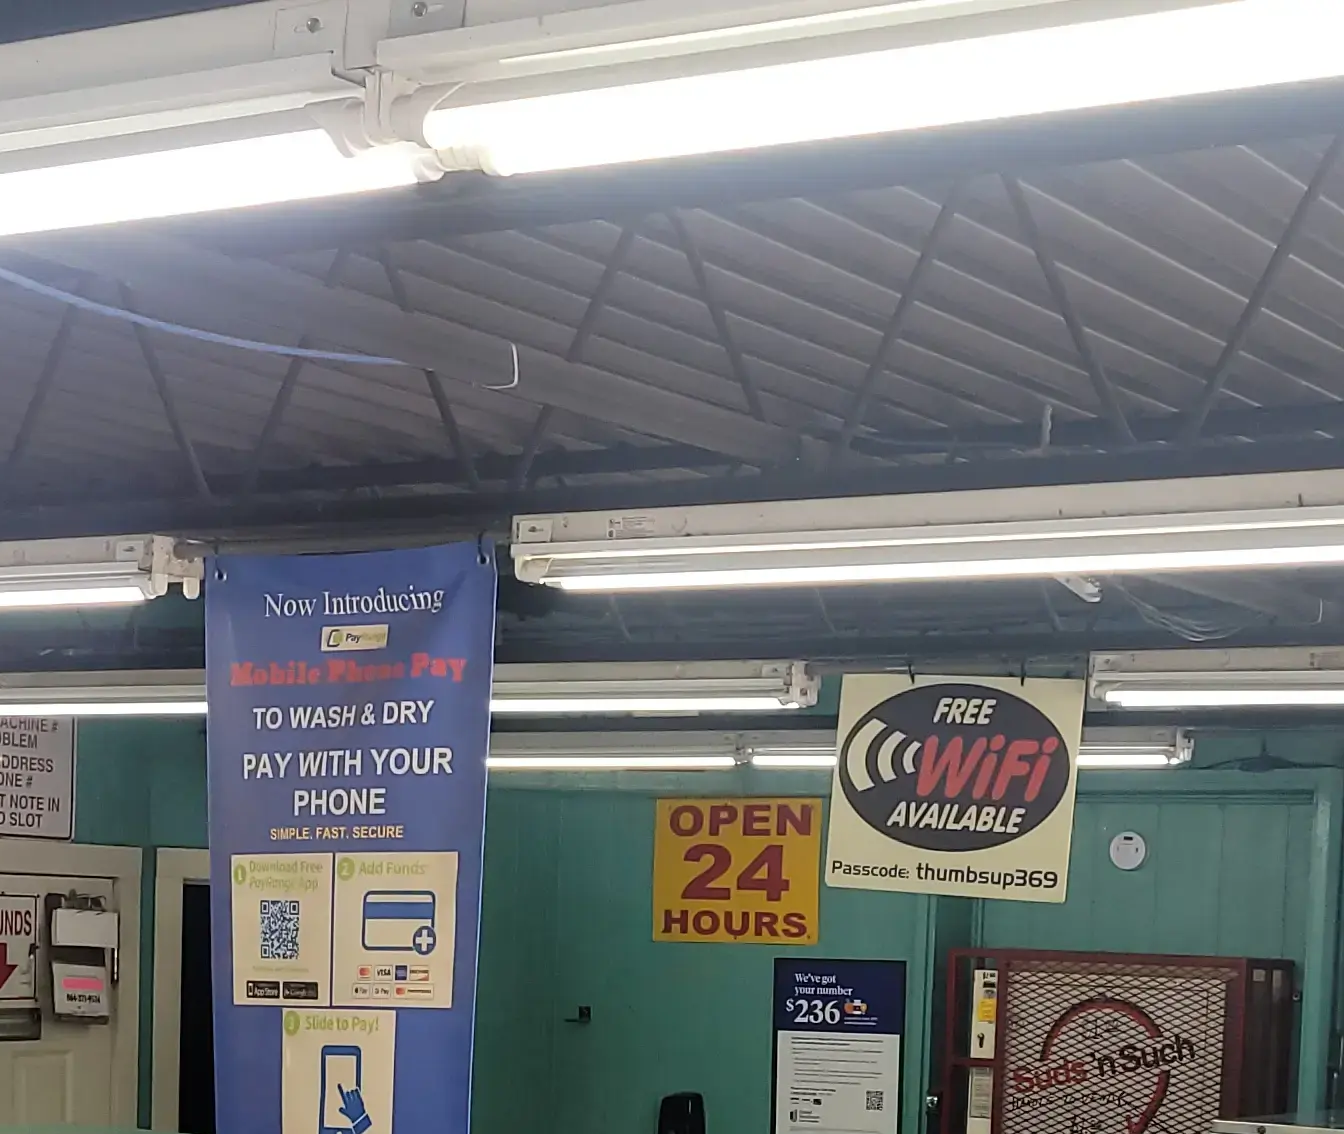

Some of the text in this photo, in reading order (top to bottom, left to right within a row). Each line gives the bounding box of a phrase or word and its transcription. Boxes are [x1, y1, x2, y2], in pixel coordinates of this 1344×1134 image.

[264, 584, 444, 617] Now Introducing
[230, 652, 467, 686] Mobile Phone Pay
[253, 700, 434, 730] TO WASH & DRY
[933, 698, 996, 725] FREE
[243, 748, 453, 779] PAY WITH YOUR
[916, 734, 1059, 801] WiFi
[26, 776, 32, 787] #
[10, 795, 44, 811] NOTE
[48, 798, 60, 812] IN
[294, 788, 386, 816] PHONE
[10, 812, 43, 828] SLOT
[669, 804, 812, 837] OPEN
[886, 801, 1027, 834] AVAILABLE
[270, 826, 404, 840] SIMPLE. FAST. SECURE
[249, 861, 297, 873] Download
[300, 861, 323, 873] Free
[359, 861, 383, 875] Add
[386, 861, 427, 875] Funds
[681, 844, 790, 901] 24
[831, 860, 1058, 890] Passcode: thumbsup369
[661, 910, 808, 938] HOURS
[795, 973, 836, 985] We've got
[795, 985, 853, 996] your number
[786, 998, 840, 1024] $236
[305, 1015, 333, 1031] Slide
[336, 1017, 348, 1031] to
[351, 1016, 379, 1035] Pay!
